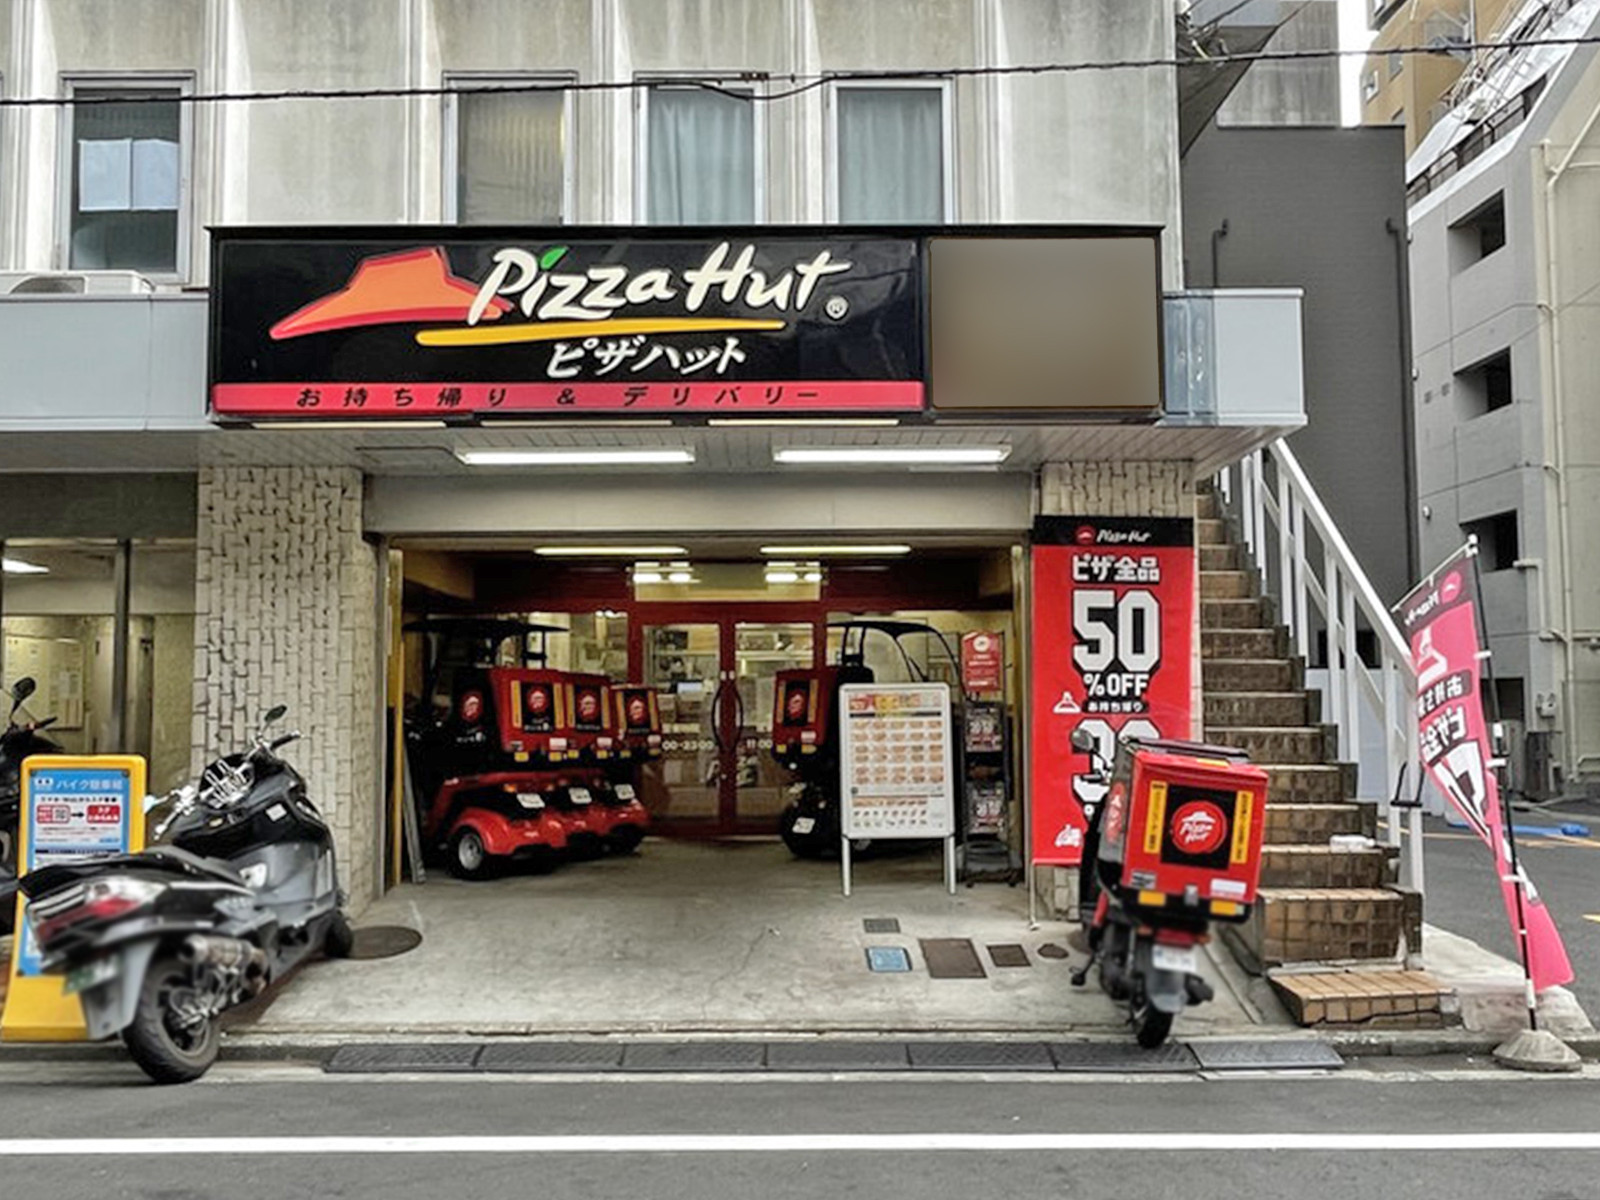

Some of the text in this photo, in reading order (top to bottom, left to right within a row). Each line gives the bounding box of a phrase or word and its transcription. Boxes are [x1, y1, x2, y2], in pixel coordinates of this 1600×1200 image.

[467, 246, 677, 325] Pizza
[683, 241, 853, 311] Hut
[546, 334, 746, 378] ピザハット
[297, 385, 819, 408] お持ち帰り & デリバリー
[1072, 553, 1160, 582] ピザ全品
[1072, 589, 1160, 671] 50
[1083, 673, 1150, 697] %OFF
